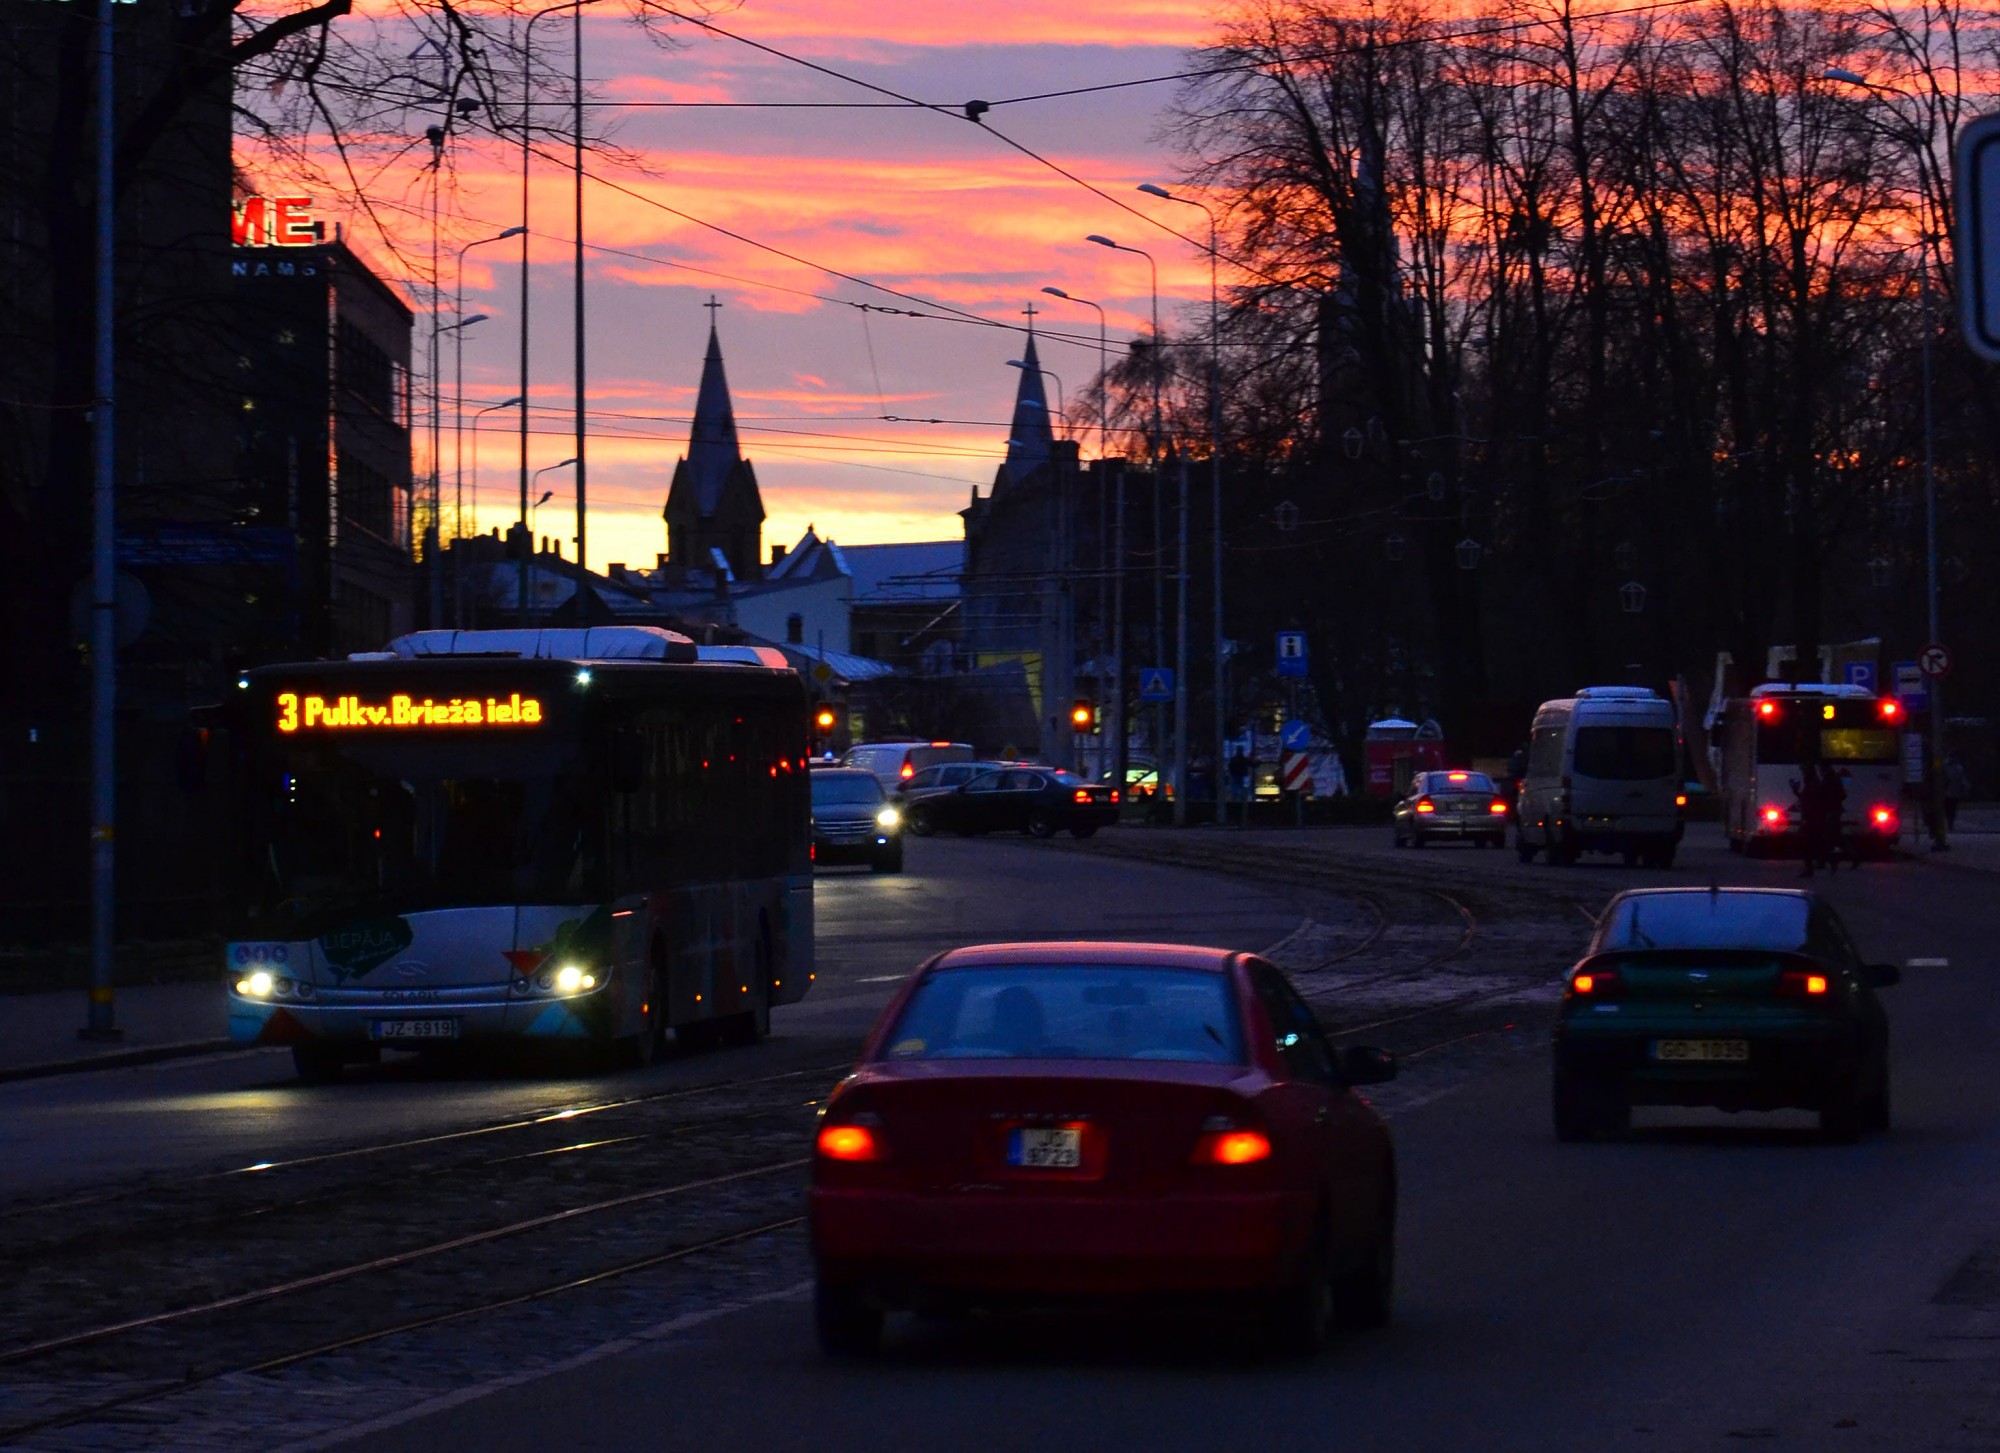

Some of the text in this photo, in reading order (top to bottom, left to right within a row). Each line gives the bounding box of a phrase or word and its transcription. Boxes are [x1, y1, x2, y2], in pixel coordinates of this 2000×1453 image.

[231, 261, 317, 277] NAMS
[1851, 666, 1869, 685] P
[278, 693, 298, 731] 3
[486, 693, 542, 723] iela
[323, 929, 395, 949] LIEPĀJA
[382, 991, 441, 1001] SOLARIS
[385, 1022, 449, 1036] JZ-6919
